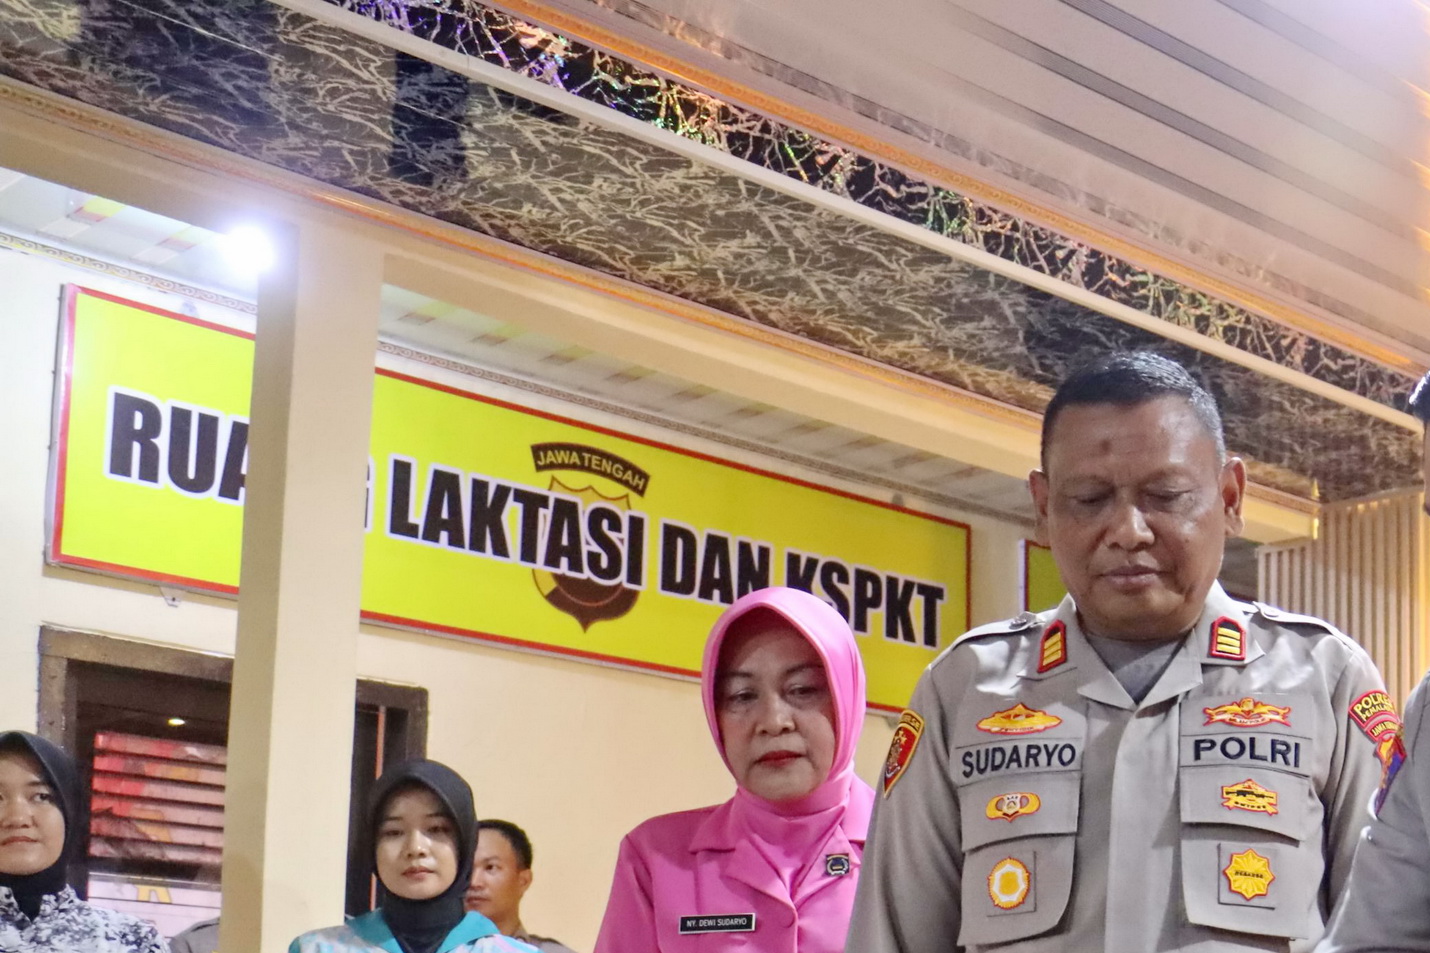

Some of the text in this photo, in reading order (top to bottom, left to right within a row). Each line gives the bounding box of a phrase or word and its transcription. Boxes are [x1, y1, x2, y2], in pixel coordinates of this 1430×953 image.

[537, 450, 645, 490] JAWA TENGAH
[389, 458, 646, 587] LAKTASI
[661, 522, 771, 604] DAN
[786, 551, 945, 648] KSPKT
[962, 743, 1077, 778] SUDARYO
[1193, 736, 1300, 768] POLRI
[699, 919, 716, 927] DEWI
[718, 918, 747, 926] SUDARYO
